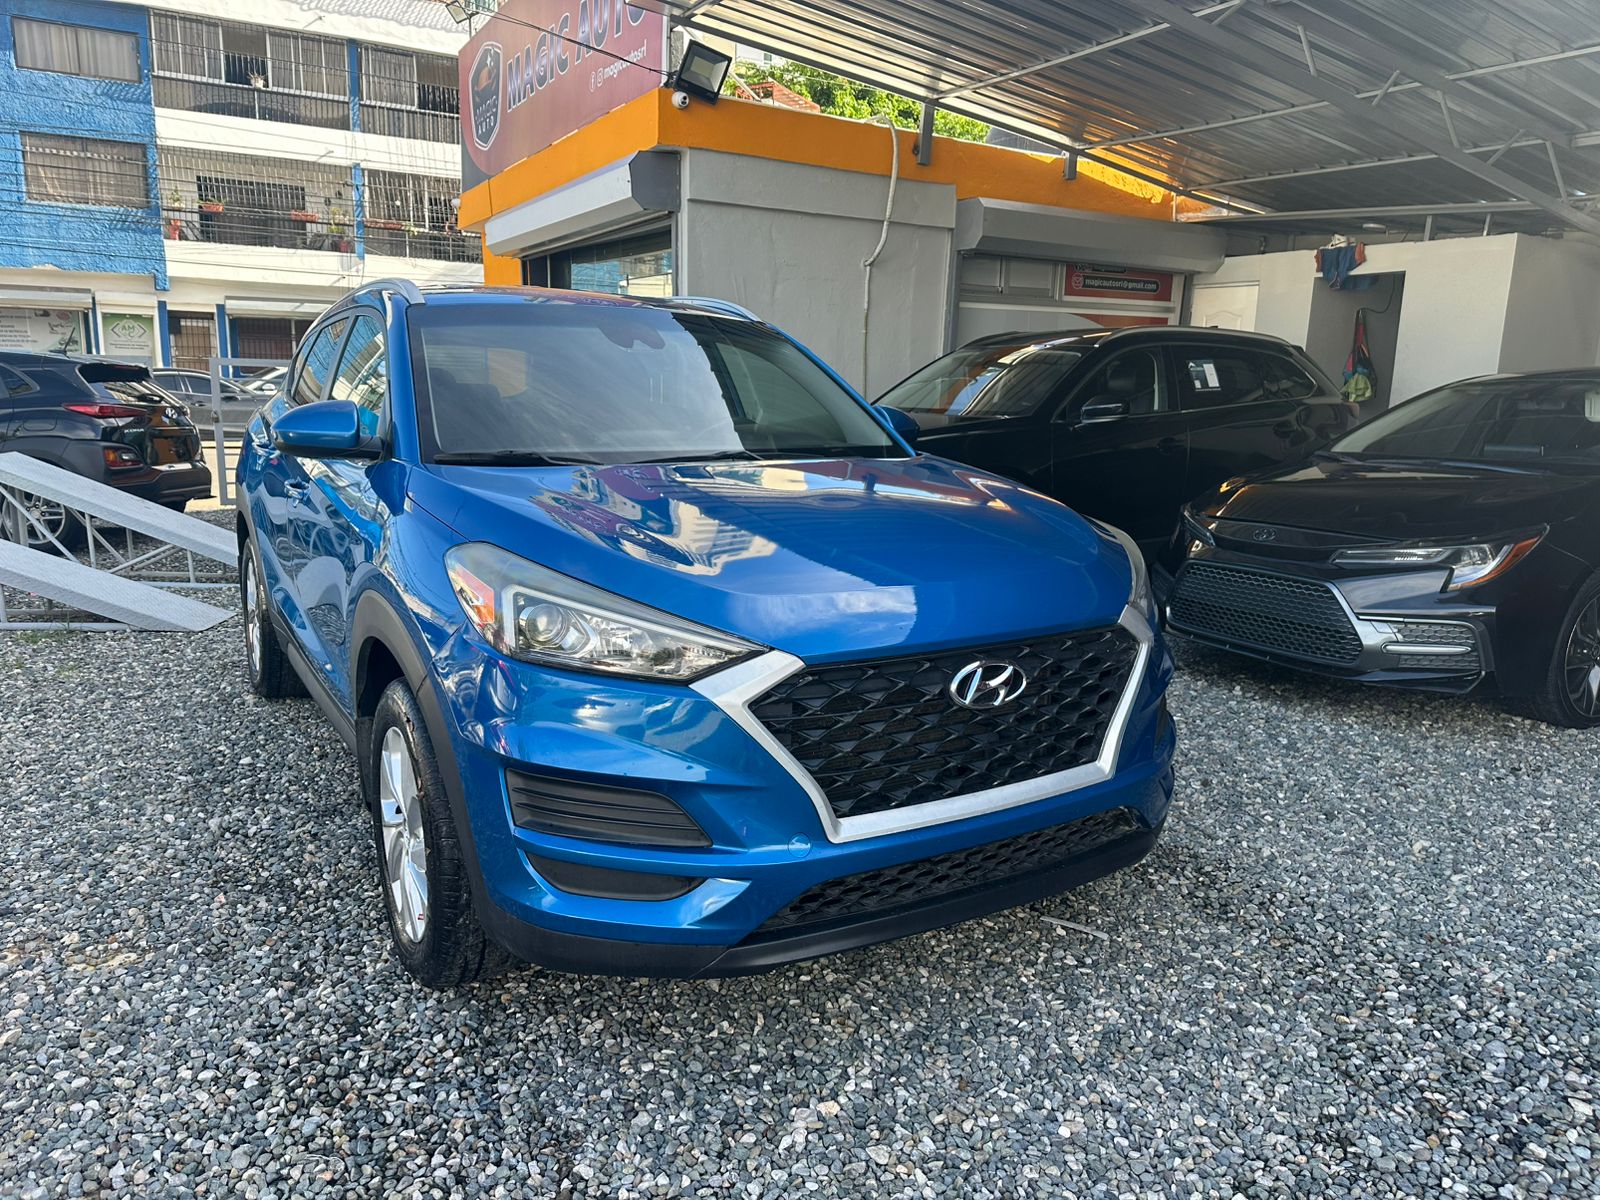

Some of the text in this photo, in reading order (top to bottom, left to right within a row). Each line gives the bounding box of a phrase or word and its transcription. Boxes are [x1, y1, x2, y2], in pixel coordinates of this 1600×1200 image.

[507, 12, 569, 112] MAGIC
[478, 115, 495, 136] AUTO
[1085, 278, 1157, 289] magicautosrl@gmail.com
